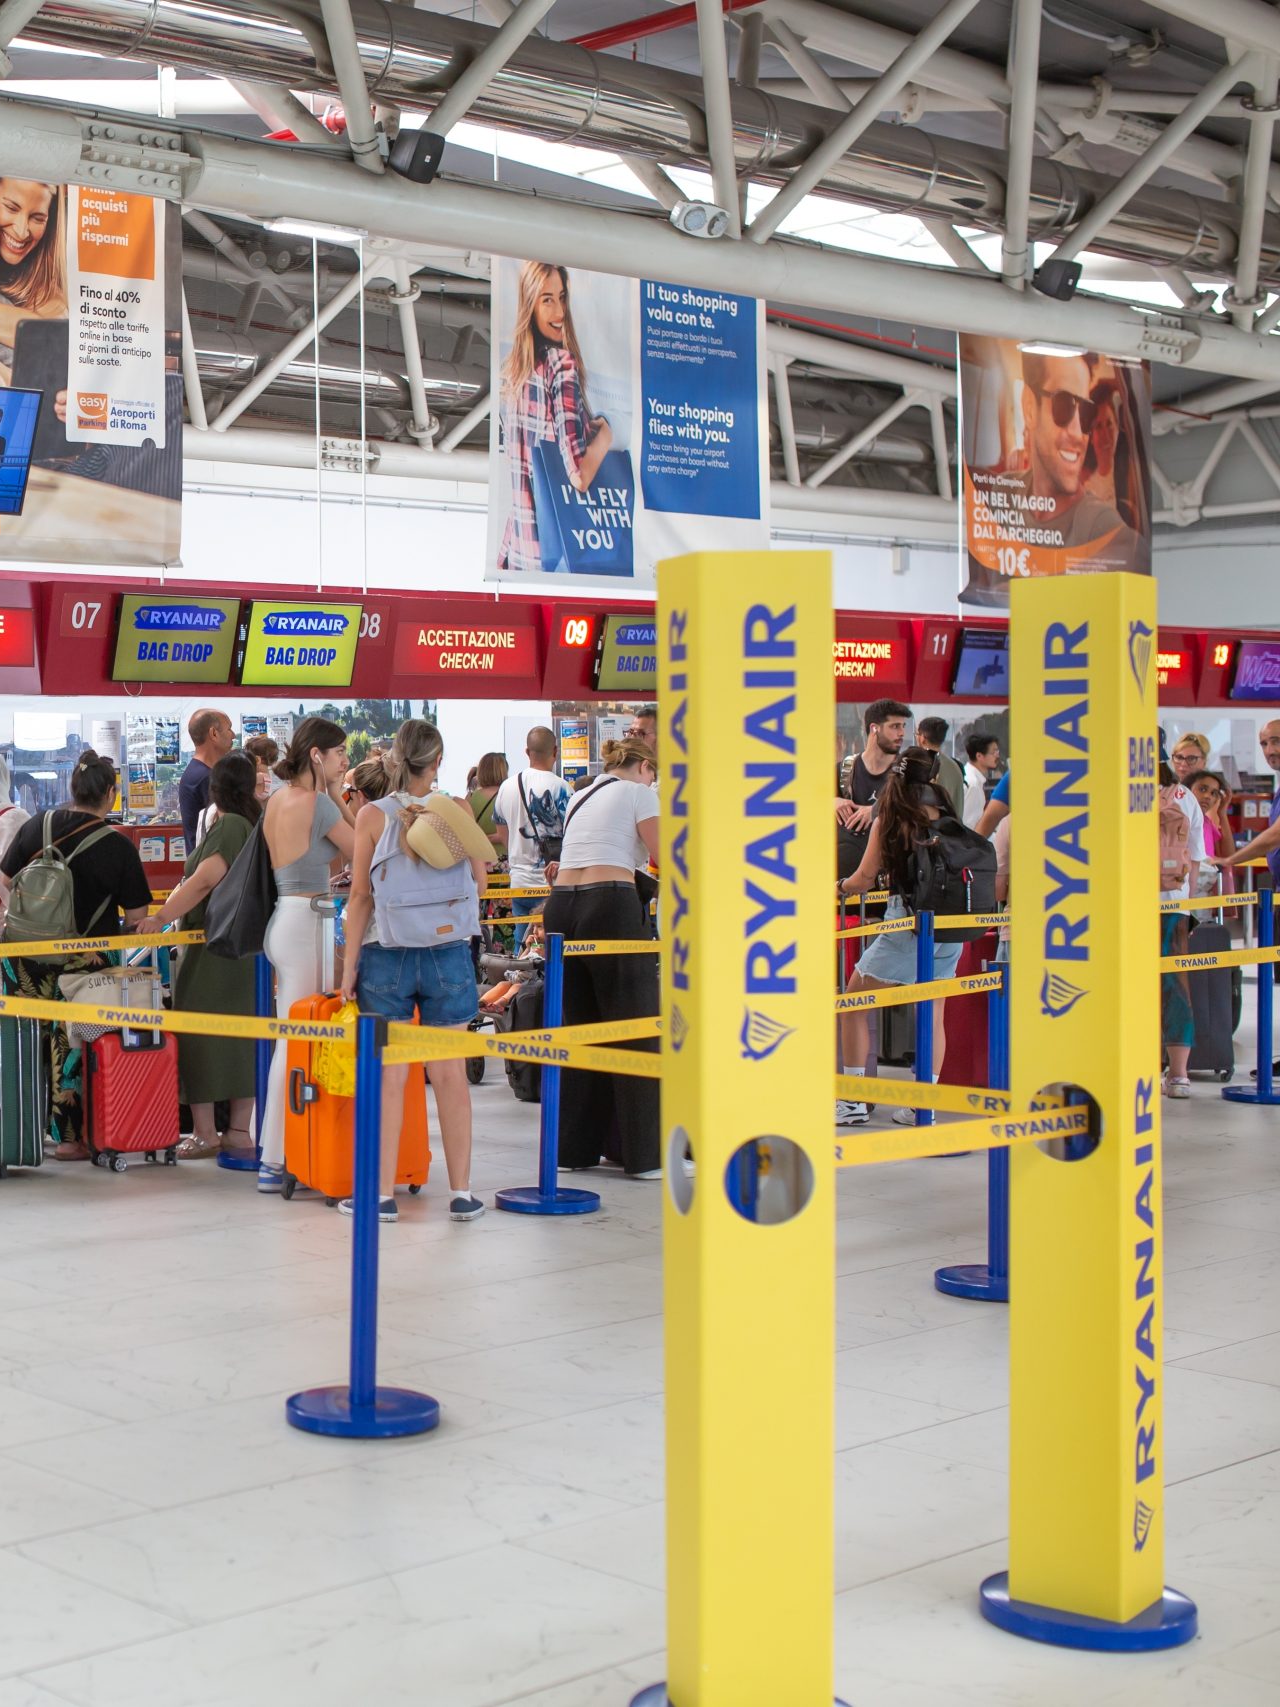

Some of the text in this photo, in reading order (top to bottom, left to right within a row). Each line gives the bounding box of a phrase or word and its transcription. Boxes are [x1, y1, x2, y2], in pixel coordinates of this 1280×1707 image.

[82, 198, 128, 213] acquisti
[81, 213, 100, 228] più
[81, 229, 129, 246] risparmi
[80, 286, 141, 303] Fino al 40%
[646, 283, 738, 317] Il tuo shopping
[80, 302, 126, 319] di sconto
[647, 305, 715, 329] vola con te.
[80, 317, 150, 334] rispetto alle tariffe
[79, 330, 133, 344] online in base
[78, 356, 95, 365] sulle
[87, 344, 109, 355] giorni
[111, 345, 120, 354] di
[122, 347, 152, 359] anticipo
[80, 397, 107, 411] easy
[110, 406, 156, 420] Aeroporti
[648, 398, 734, 428] Your shopping
[110, 418, 147, 431] di Roma
[648, 420, 730, 445] flies with you.
[648, 441, 660, 450] You
[661, 444, 672, 452] can
[673, 444, 689, 456] bring
[703, 448, 725, 460] airport
[648, 453, 678, 466] purchases
[688, 456, 706, 467] board
[706, 458, 729, 469] without
[598, 488, 628, 508] FLY
[973, 491, 1056, 512] UN BEL VIAGGIO
[586, 508, 632, 528] WITH
[973, 507, 1025, 527] COMINCIA
[571, 529, 614, 550] YOU
[973, 524, 1064, 546] DAL PARCHEGGIO.
[997, 547, 1031, 577] 10€
[71, 602, 101, 629] 07
[150, 611, 221, 627] RYANAIR
[277, 616, 344, 631] RYANAIR
[359, 612, 381, 638] 08
[418, 629, 516, 648] ACCETTAZIONE
[564, 619, 589, 645] 09
[627, 628, 657, 642] RYAN
[137, 641, 213, 662] BAG DROP
[832, 642, 891, 658] CETTAZIONE
[933, 634, 948, 656] 11
[265, 646, 295, 665] BAG
[297, 648, 336, 666] DROP
[439, 652, 495, 670] CHECK-IN
[617, 655, 657, 673] BAG DR
[1213, 644, 1229, 666] 13
[833, 661, 876, 677] CHECK-IN
[1128, 736, 1155, 778] BAG
[669, 609, 688, 990] RYANAIR
[744, 604, 797, 995] RYANAIR
[1043, 621, 1090, 962] RYANAIR
[1128, 783, 1155, 813] DROP
[1158, 902, 1180, 911] ANAIR
[880, 920, 913, 931] RYANAIR
[62, 939, 110, 951] RYANAIR
[563, 943, 596, 953] YANAIR
[1181, 956, 1218, 968] RYANAIR
[106, 1010, 164, 1025] RYANAIR
[278, 1022, 345, 1039] RYANAIR
[497, 1041, 569, 1062] RYANAIR
[1005, 1113, 1088, 1139] RYANAIR
[1135, 1077, 1154, 1484] RYANAIR
